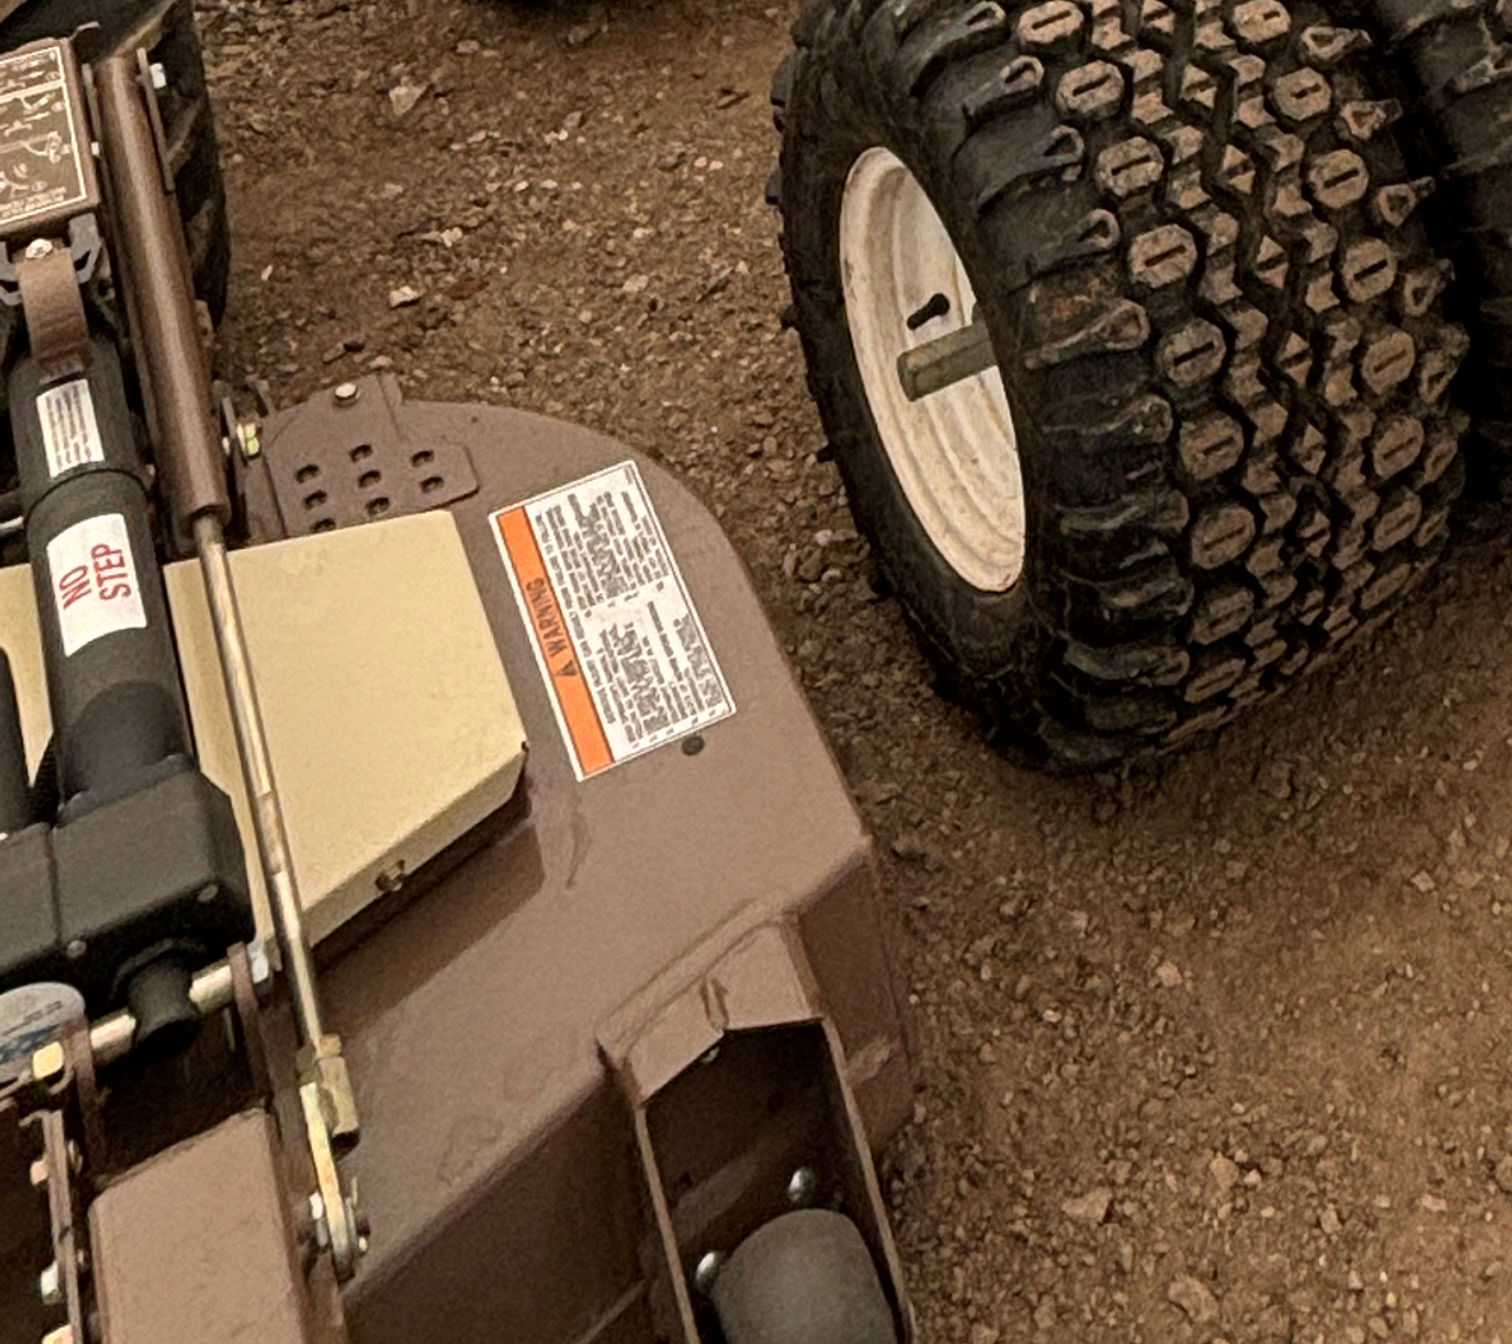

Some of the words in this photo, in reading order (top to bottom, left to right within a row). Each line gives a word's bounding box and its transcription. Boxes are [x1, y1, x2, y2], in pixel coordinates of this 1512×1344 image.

[59, 564, 92, 610] NO
[90, 542, 132, 602] STEP
[525, 576, 568, 659] WARNING
